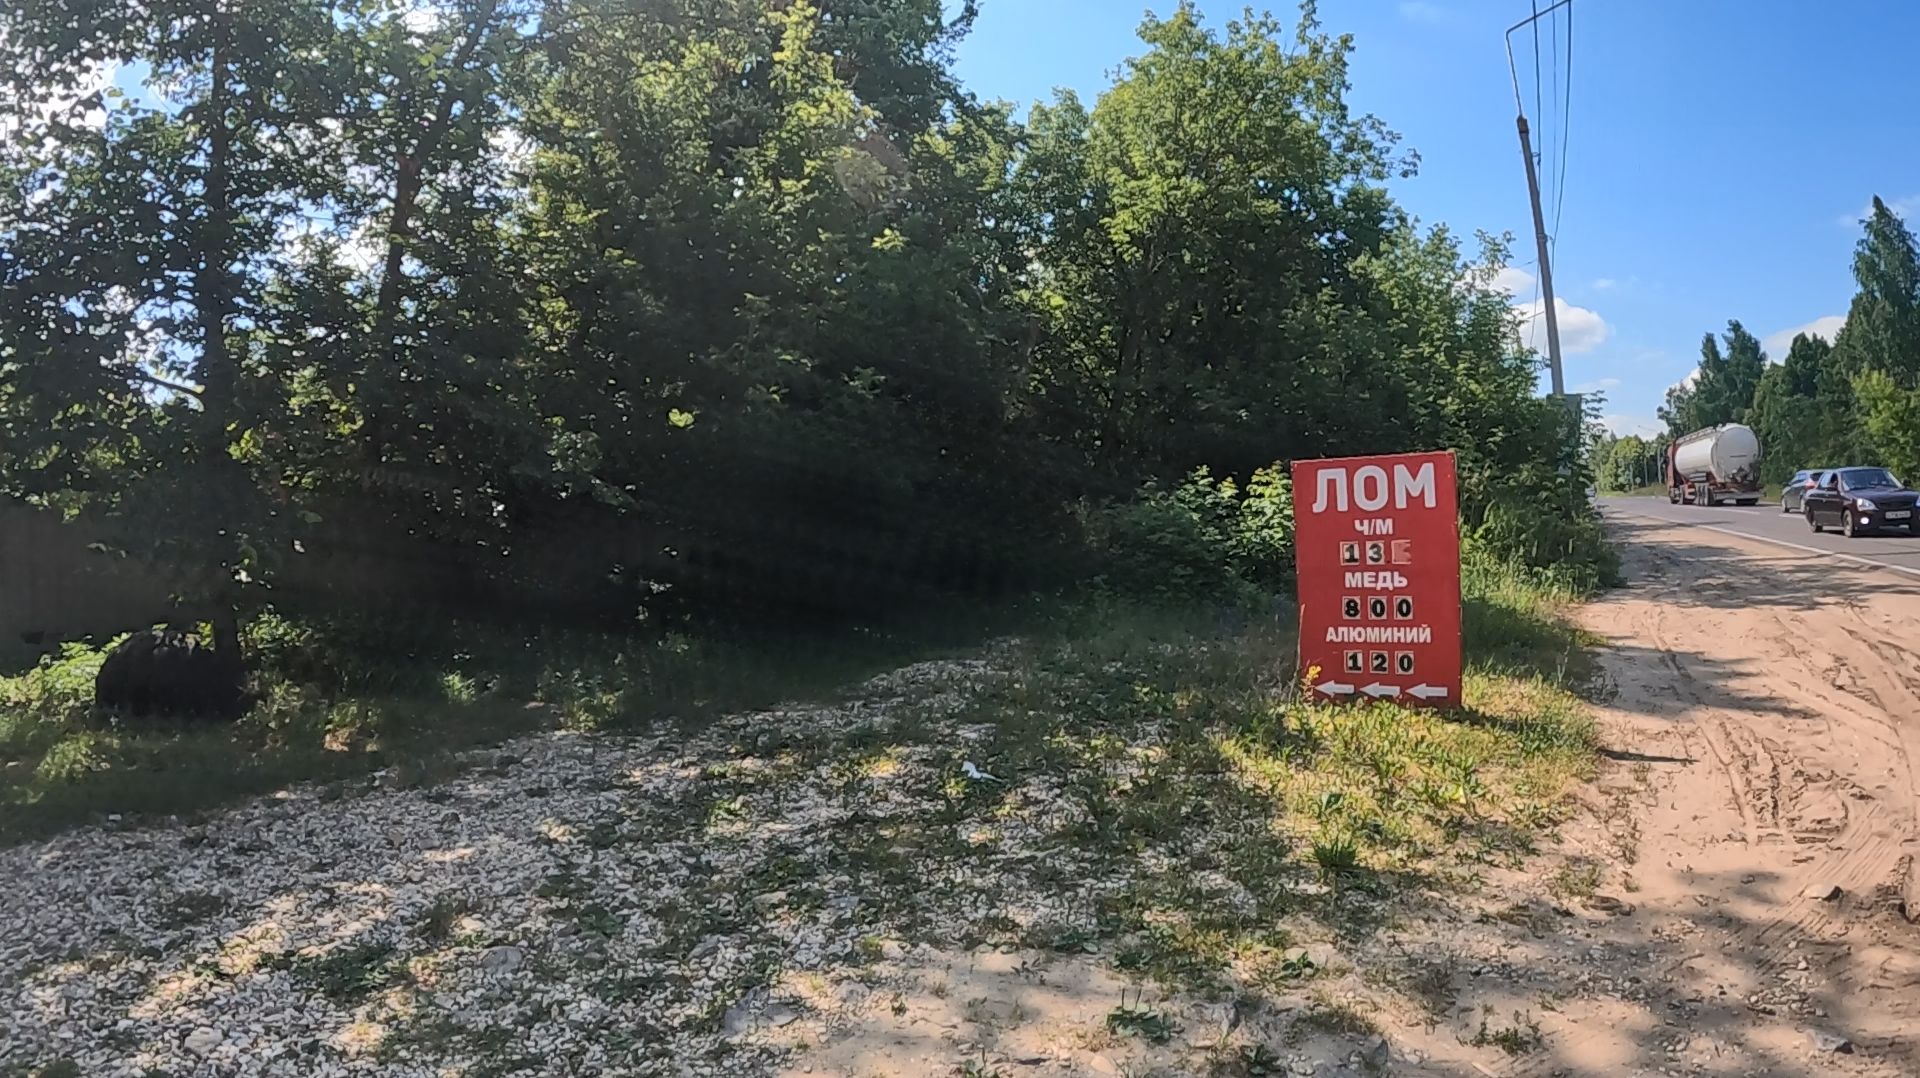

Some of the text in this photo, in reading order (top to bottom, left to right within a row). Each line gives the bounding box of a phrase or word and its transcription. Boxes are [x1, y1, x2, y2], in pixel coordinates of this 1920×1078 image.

[1312, 462, 1436, 513] ЛОМ
[1354, 518, 1393, 535] Ч/М
[1345, 571, 1408, 590] МЕДЬ
[1344, 599, 1412, 618] 800
[1326, 624, 1431, 643] АЛЮМИНИЙ
[1347, 653, 1414, 672] 120
